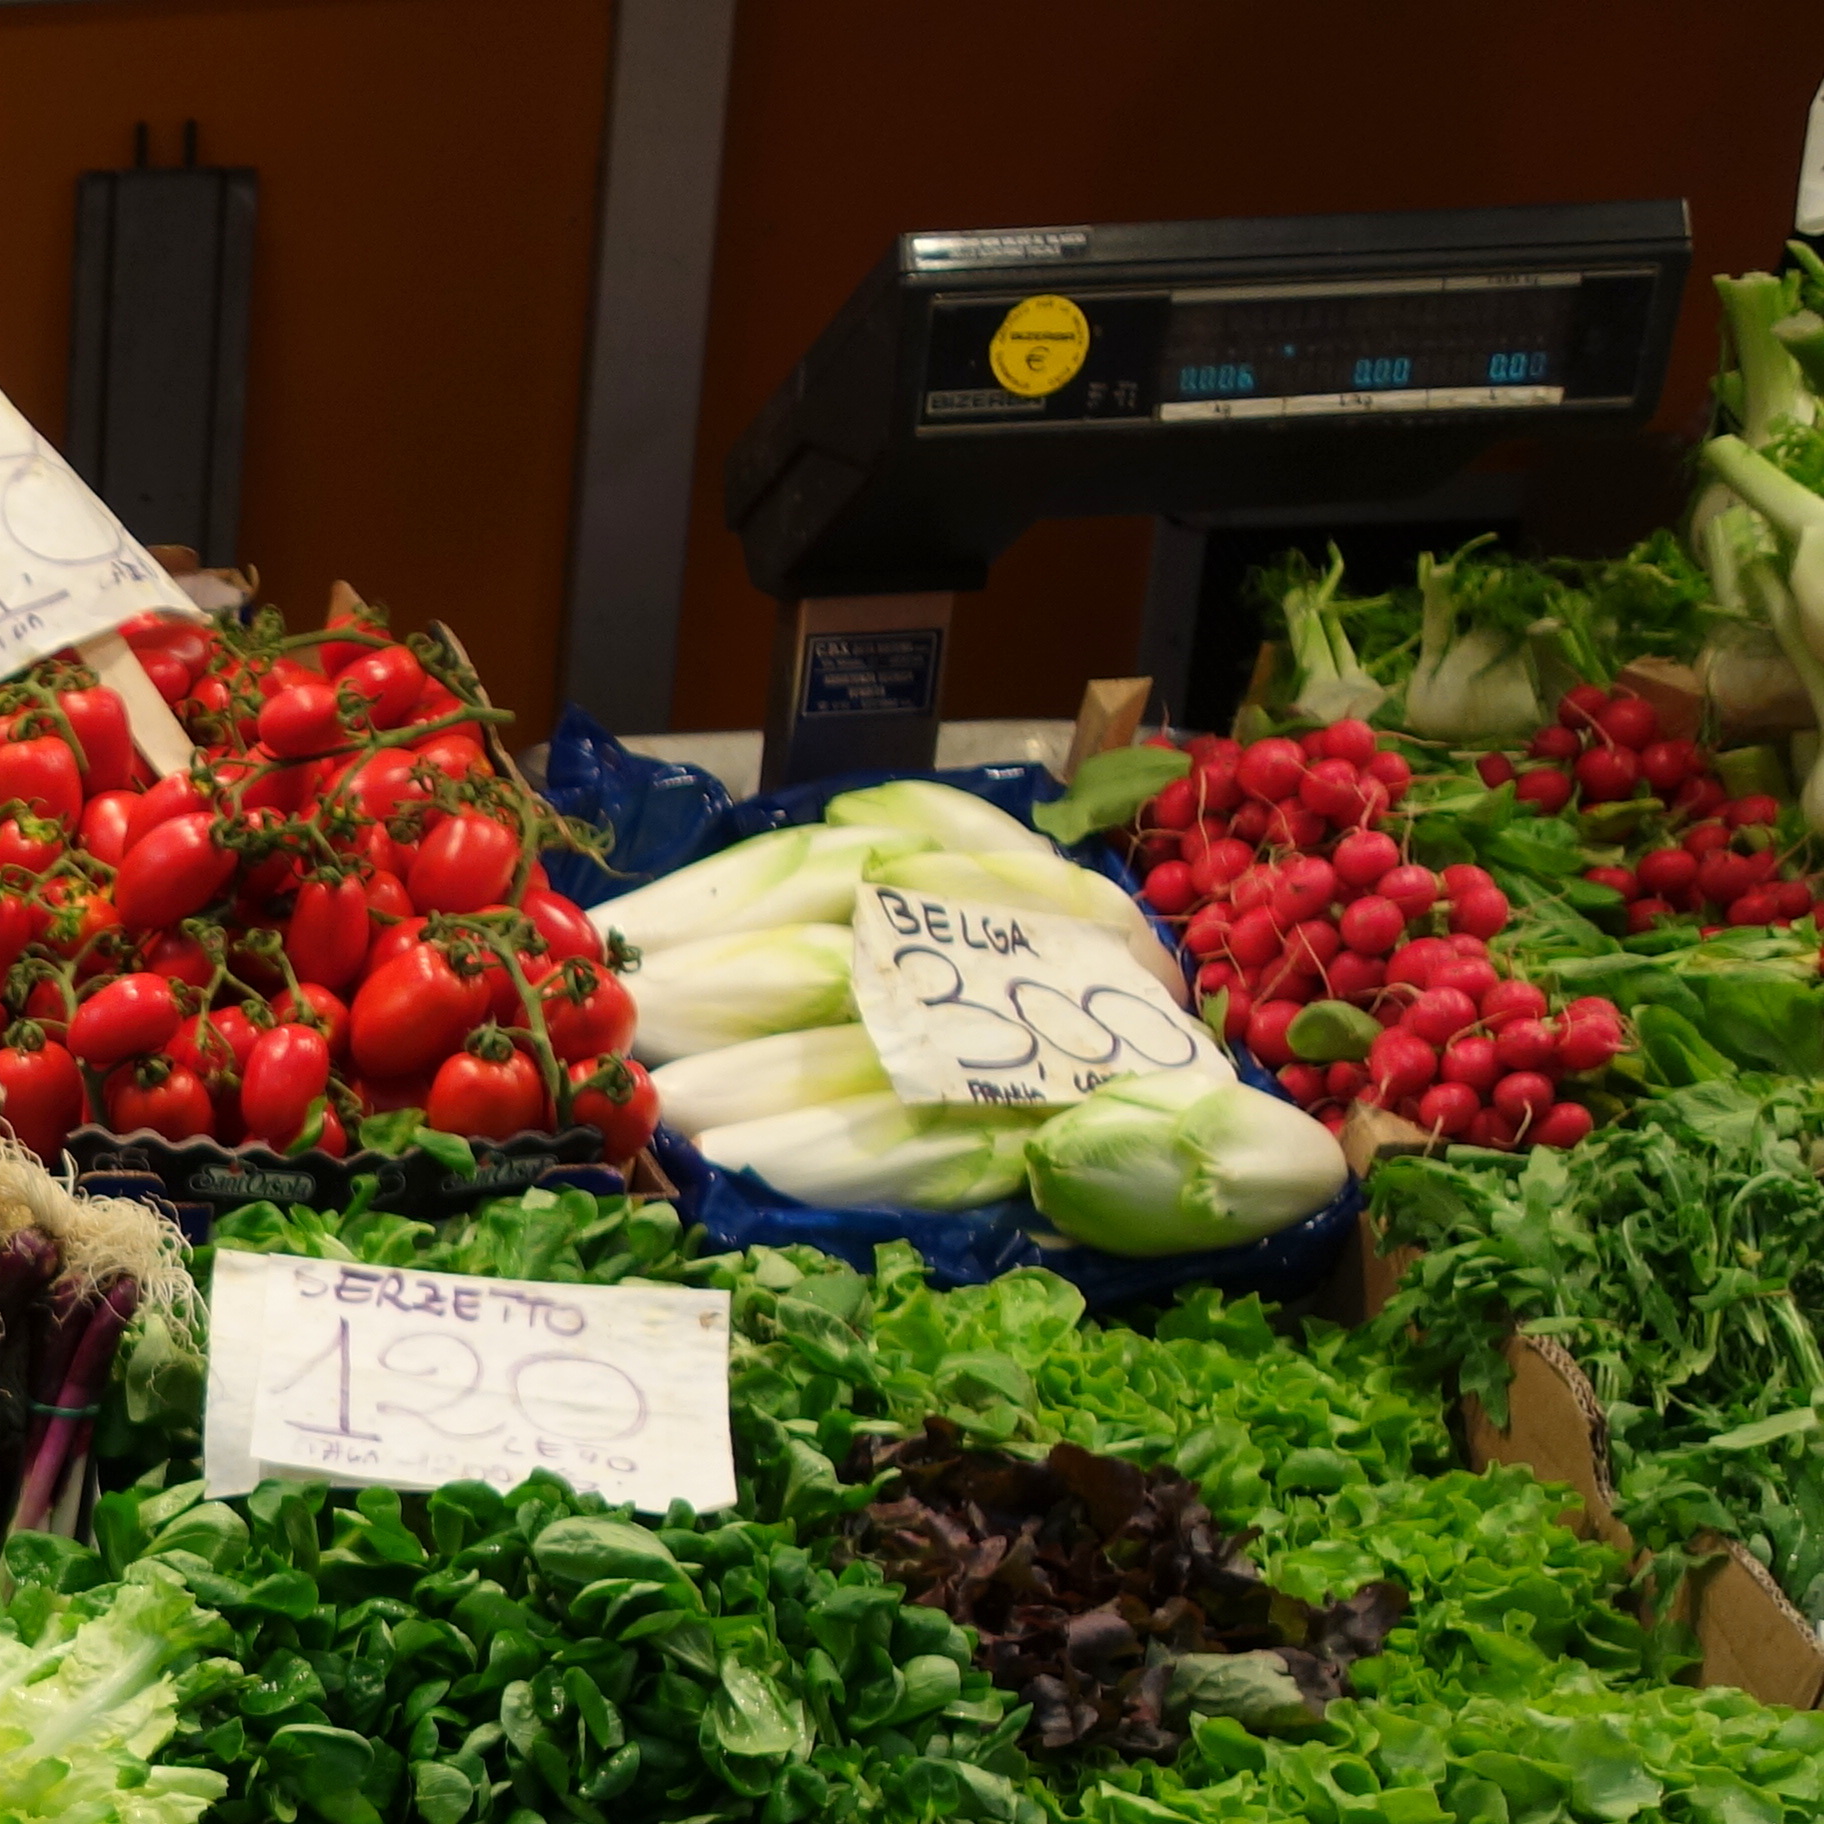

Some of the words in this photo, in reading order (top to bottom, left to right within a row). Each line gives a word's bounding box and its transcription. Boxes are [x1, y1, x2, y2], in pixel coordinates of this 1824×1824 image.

[876, 885, 1041, 958] BELGA
[293, 1265, 586, 1338] SERZETTO
[268, 1315, 650, 1442] 120
